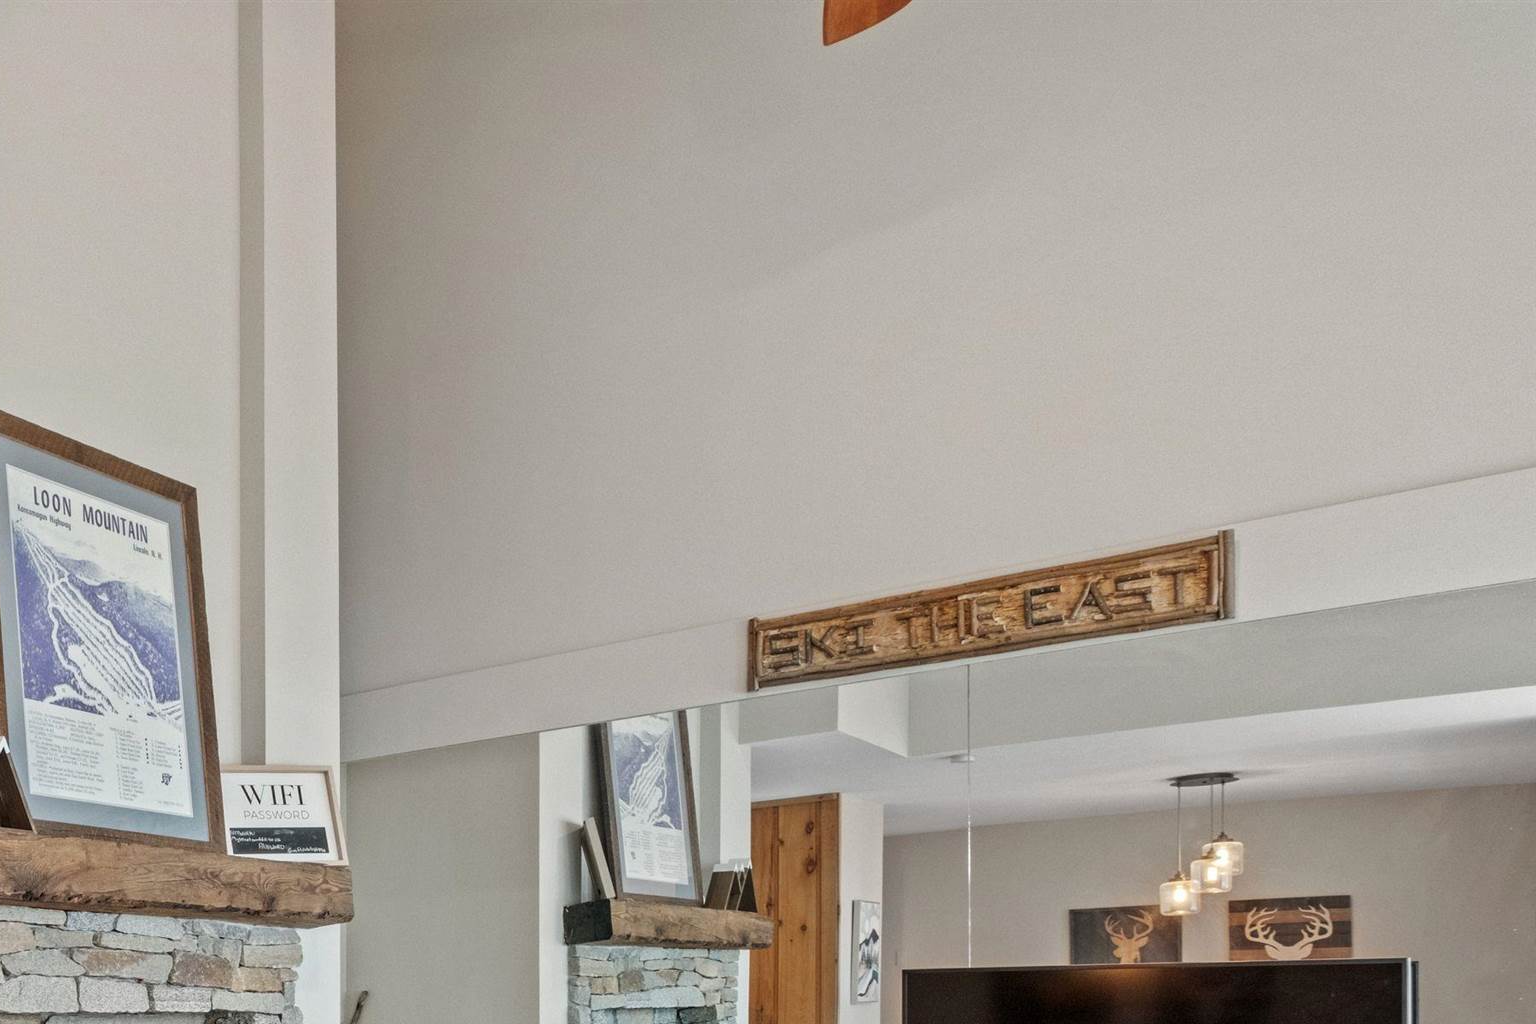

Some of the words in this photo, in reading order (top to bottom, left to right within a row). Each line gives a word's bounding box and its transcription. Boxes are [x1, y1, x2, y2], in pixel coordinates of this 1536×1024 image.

[33, 486, 72, 517] LOON
[82, 504, 149, 543] MOUNTAIN
[764, 619, 876, 673] SKI
[895, 595, 1007, 645] THE
[1025, 562, 1200, 630] EAST
[238, 784, 307, 806] WIFI
[243, 810, 310, 820] PASSWORD
